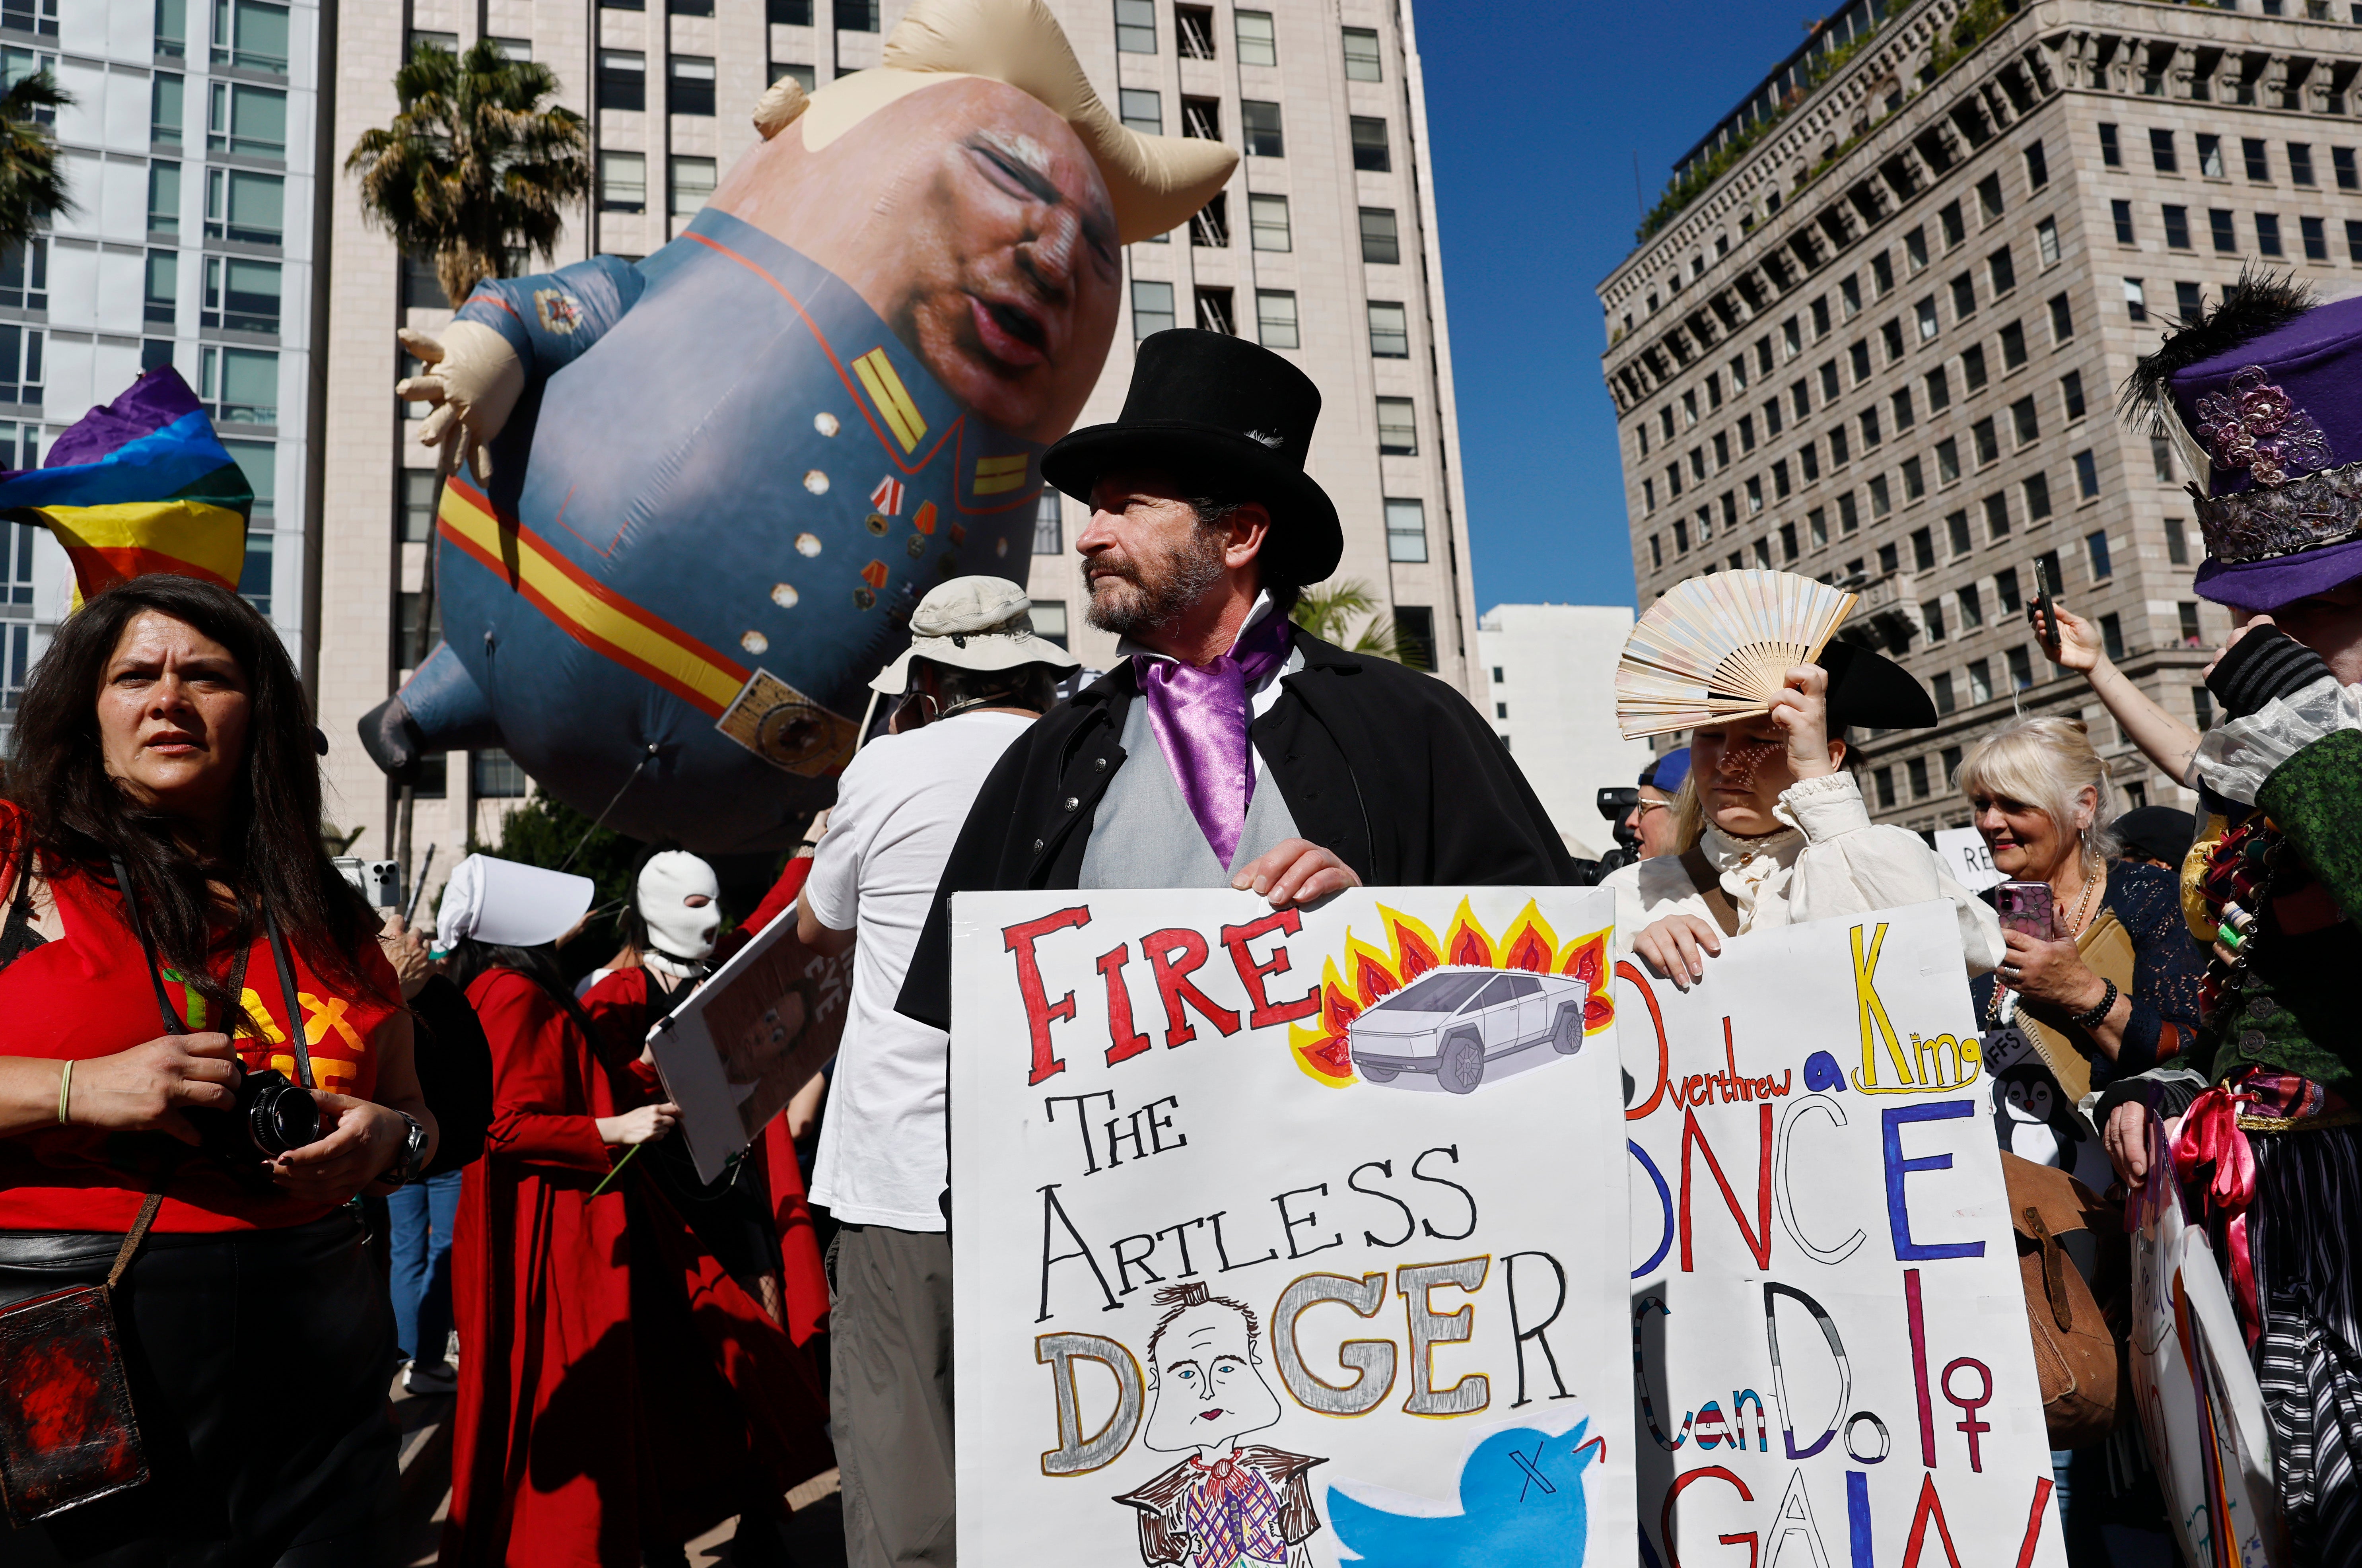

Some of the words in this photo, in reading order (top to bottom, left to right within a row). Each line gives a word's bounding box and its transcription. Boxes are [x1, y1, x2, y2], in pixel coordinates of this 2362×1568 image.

[1002, 905, 1321, 1086] FIRE
[1804, 1050, 1847, 1092] a
[1851, 923, 1983, 1095] King
[1983, 1032, 2021, 1073] IFFS
[1045, 1090, 1186, 1175] THE
[1034, 1144, 1477, 1323] ARTLESS
[1634, 1296, 1768, 1453] Can
[1764, 1281, 1891, 1465] Do
[1639, 1466, 2053, 1568] GAIN
